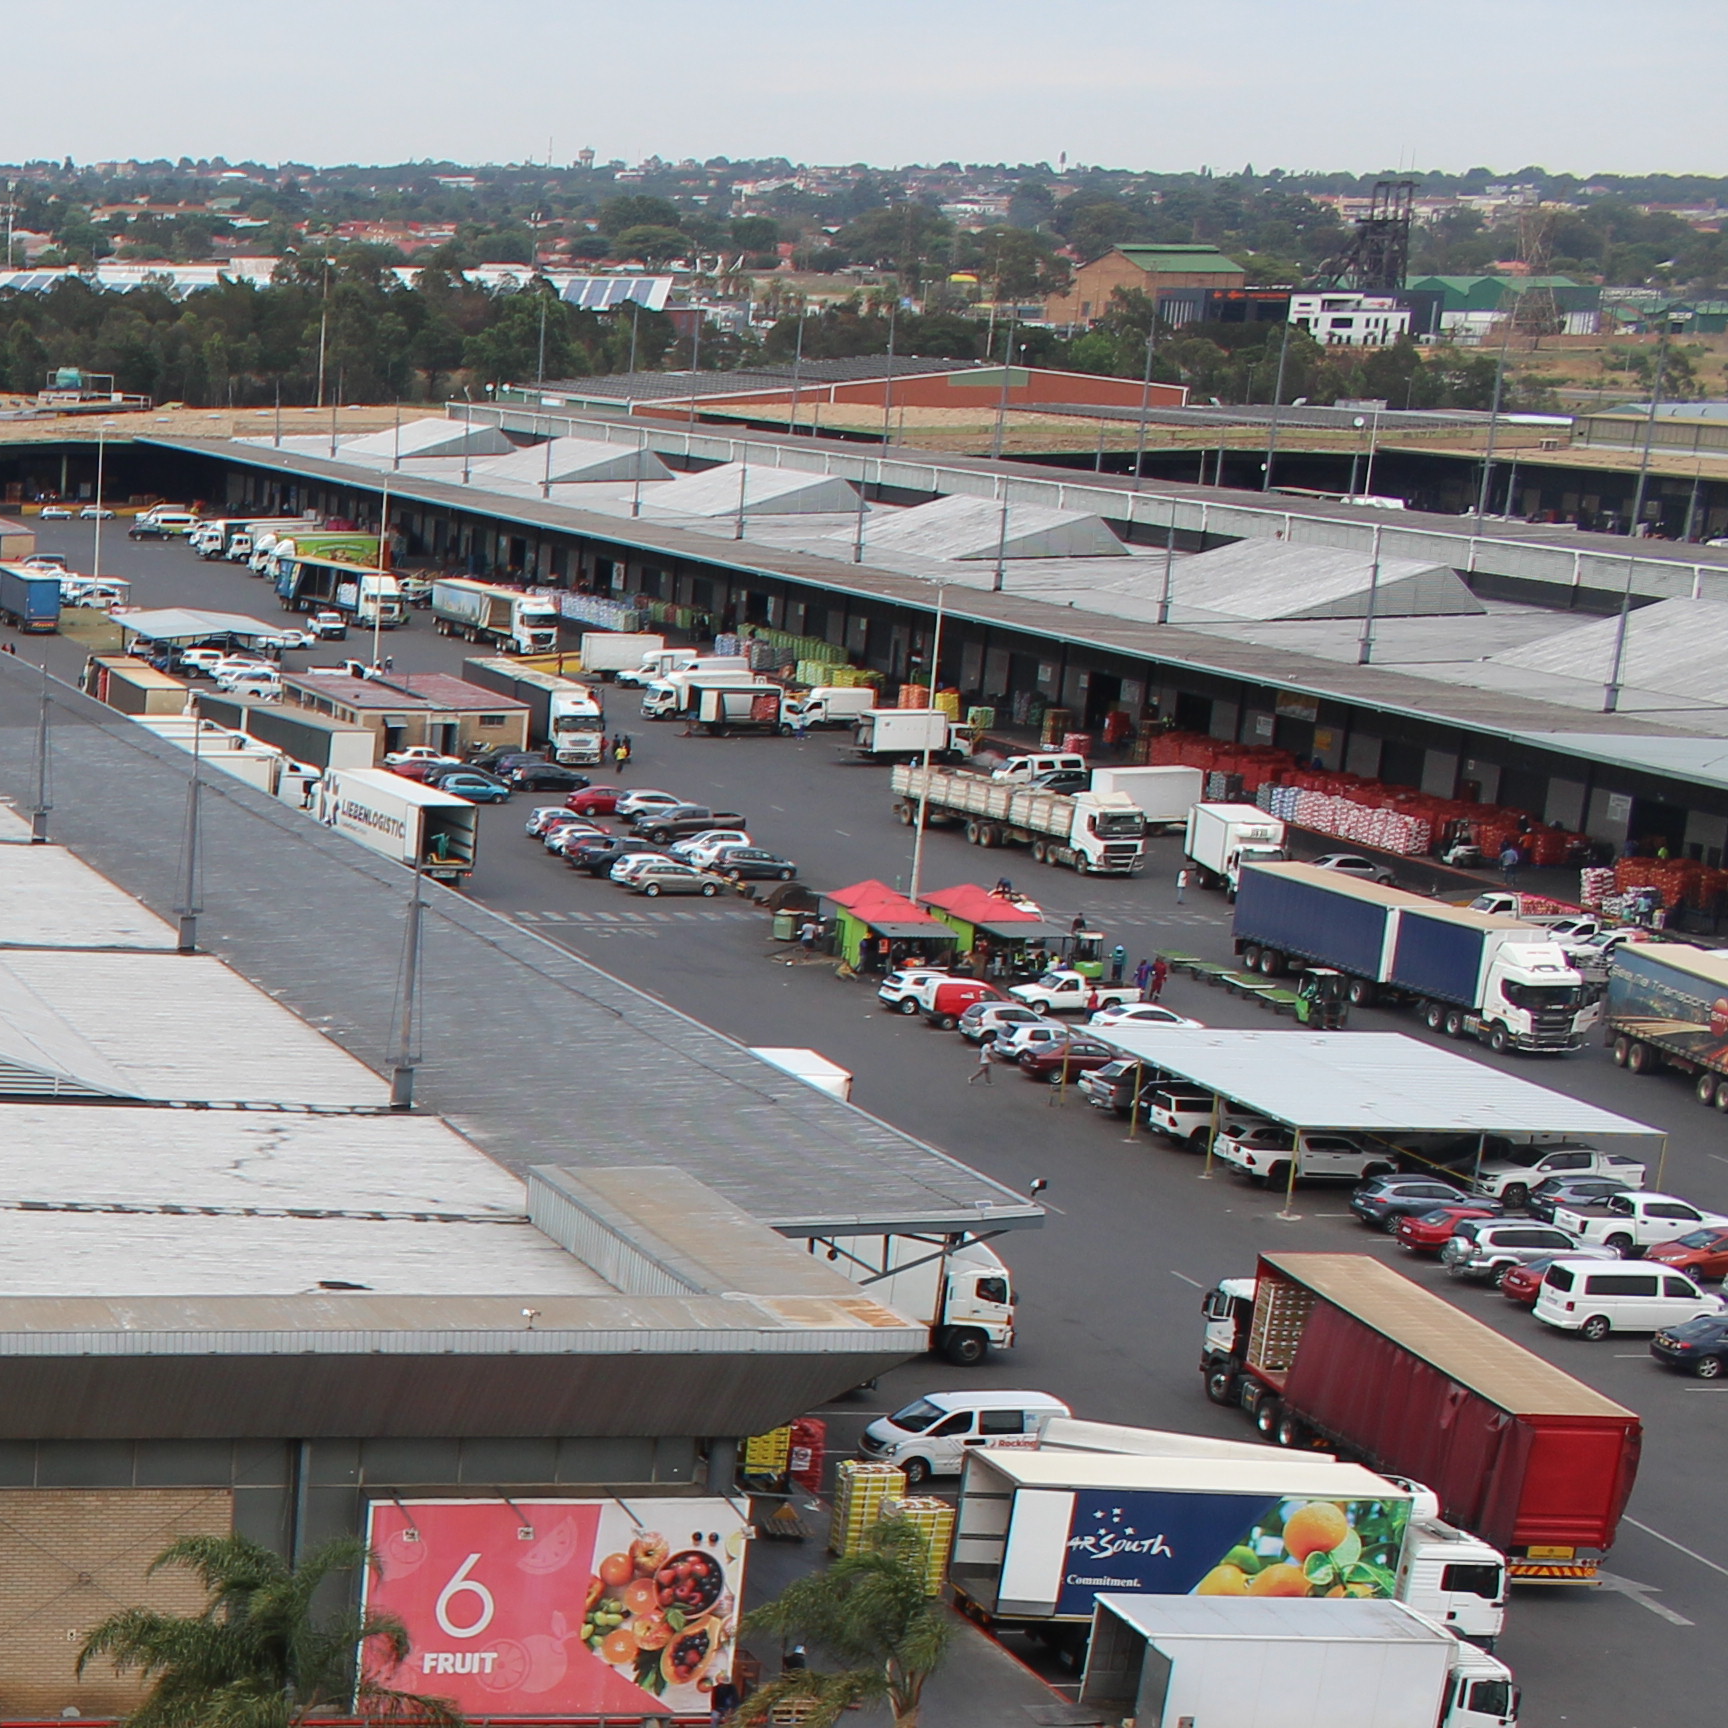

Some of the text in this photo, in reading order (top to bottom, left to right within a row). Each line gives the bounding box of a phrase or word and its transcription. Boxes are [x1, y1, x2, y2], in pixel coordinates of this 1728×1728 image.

[341, 799, 406, 839] LIEBENLOGISTIC
[434, 1552, 494, 1639] 6
[1067, 1574, 1142, 1587] Commitment.
[422, 1652, 498, 1675] FRUIT
